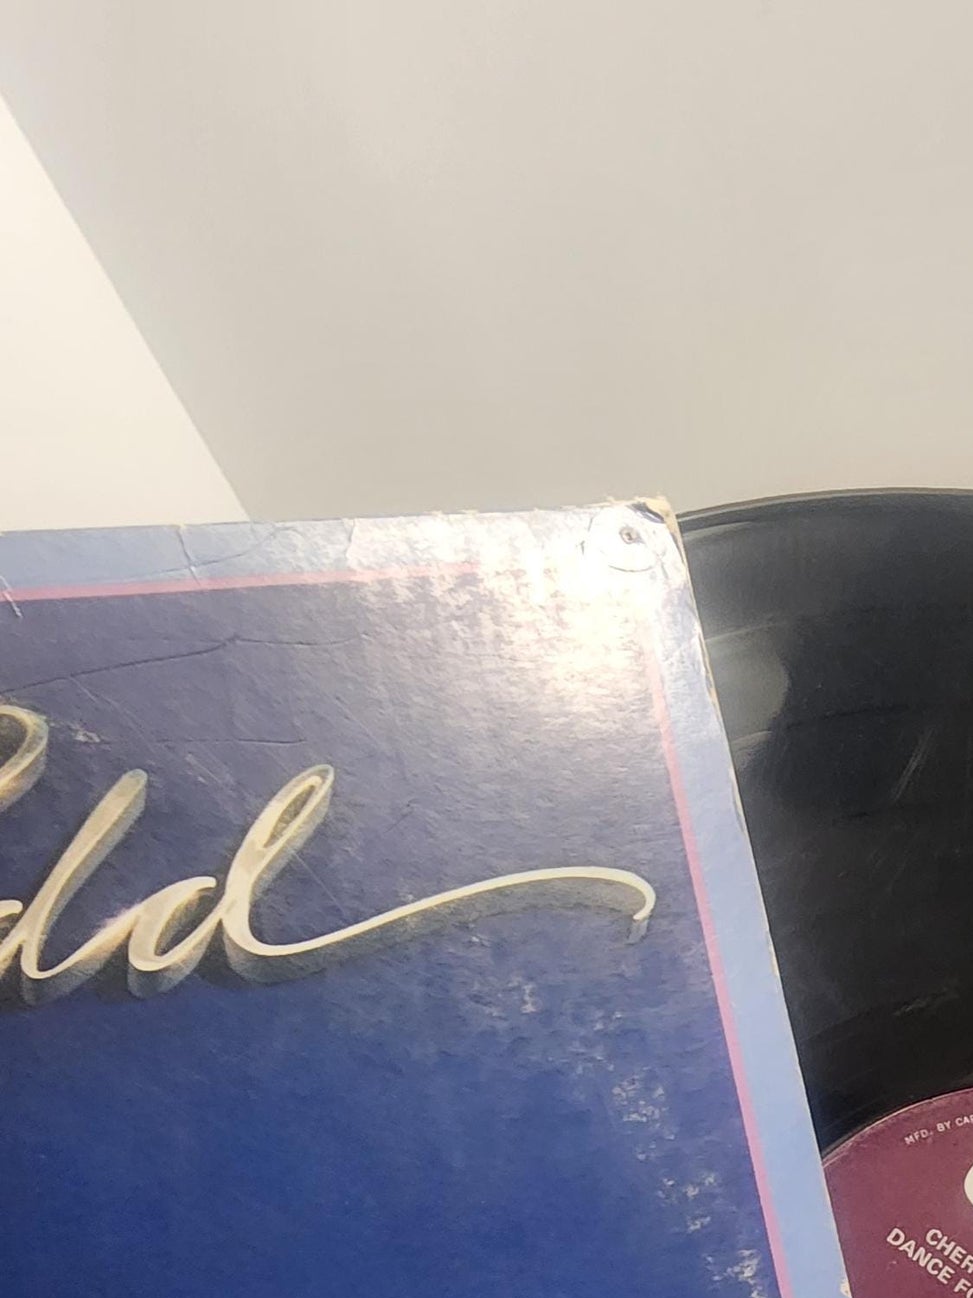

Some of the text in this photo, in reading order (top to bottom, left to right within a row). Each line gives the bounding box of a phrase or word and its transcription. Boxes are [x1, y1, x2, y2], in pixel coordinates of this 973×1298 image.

[904, 1129, 933, 1145] MFD.
[936, 1120, 951, 1132] BY
[886, 1227, 956, 1285] DANCE
